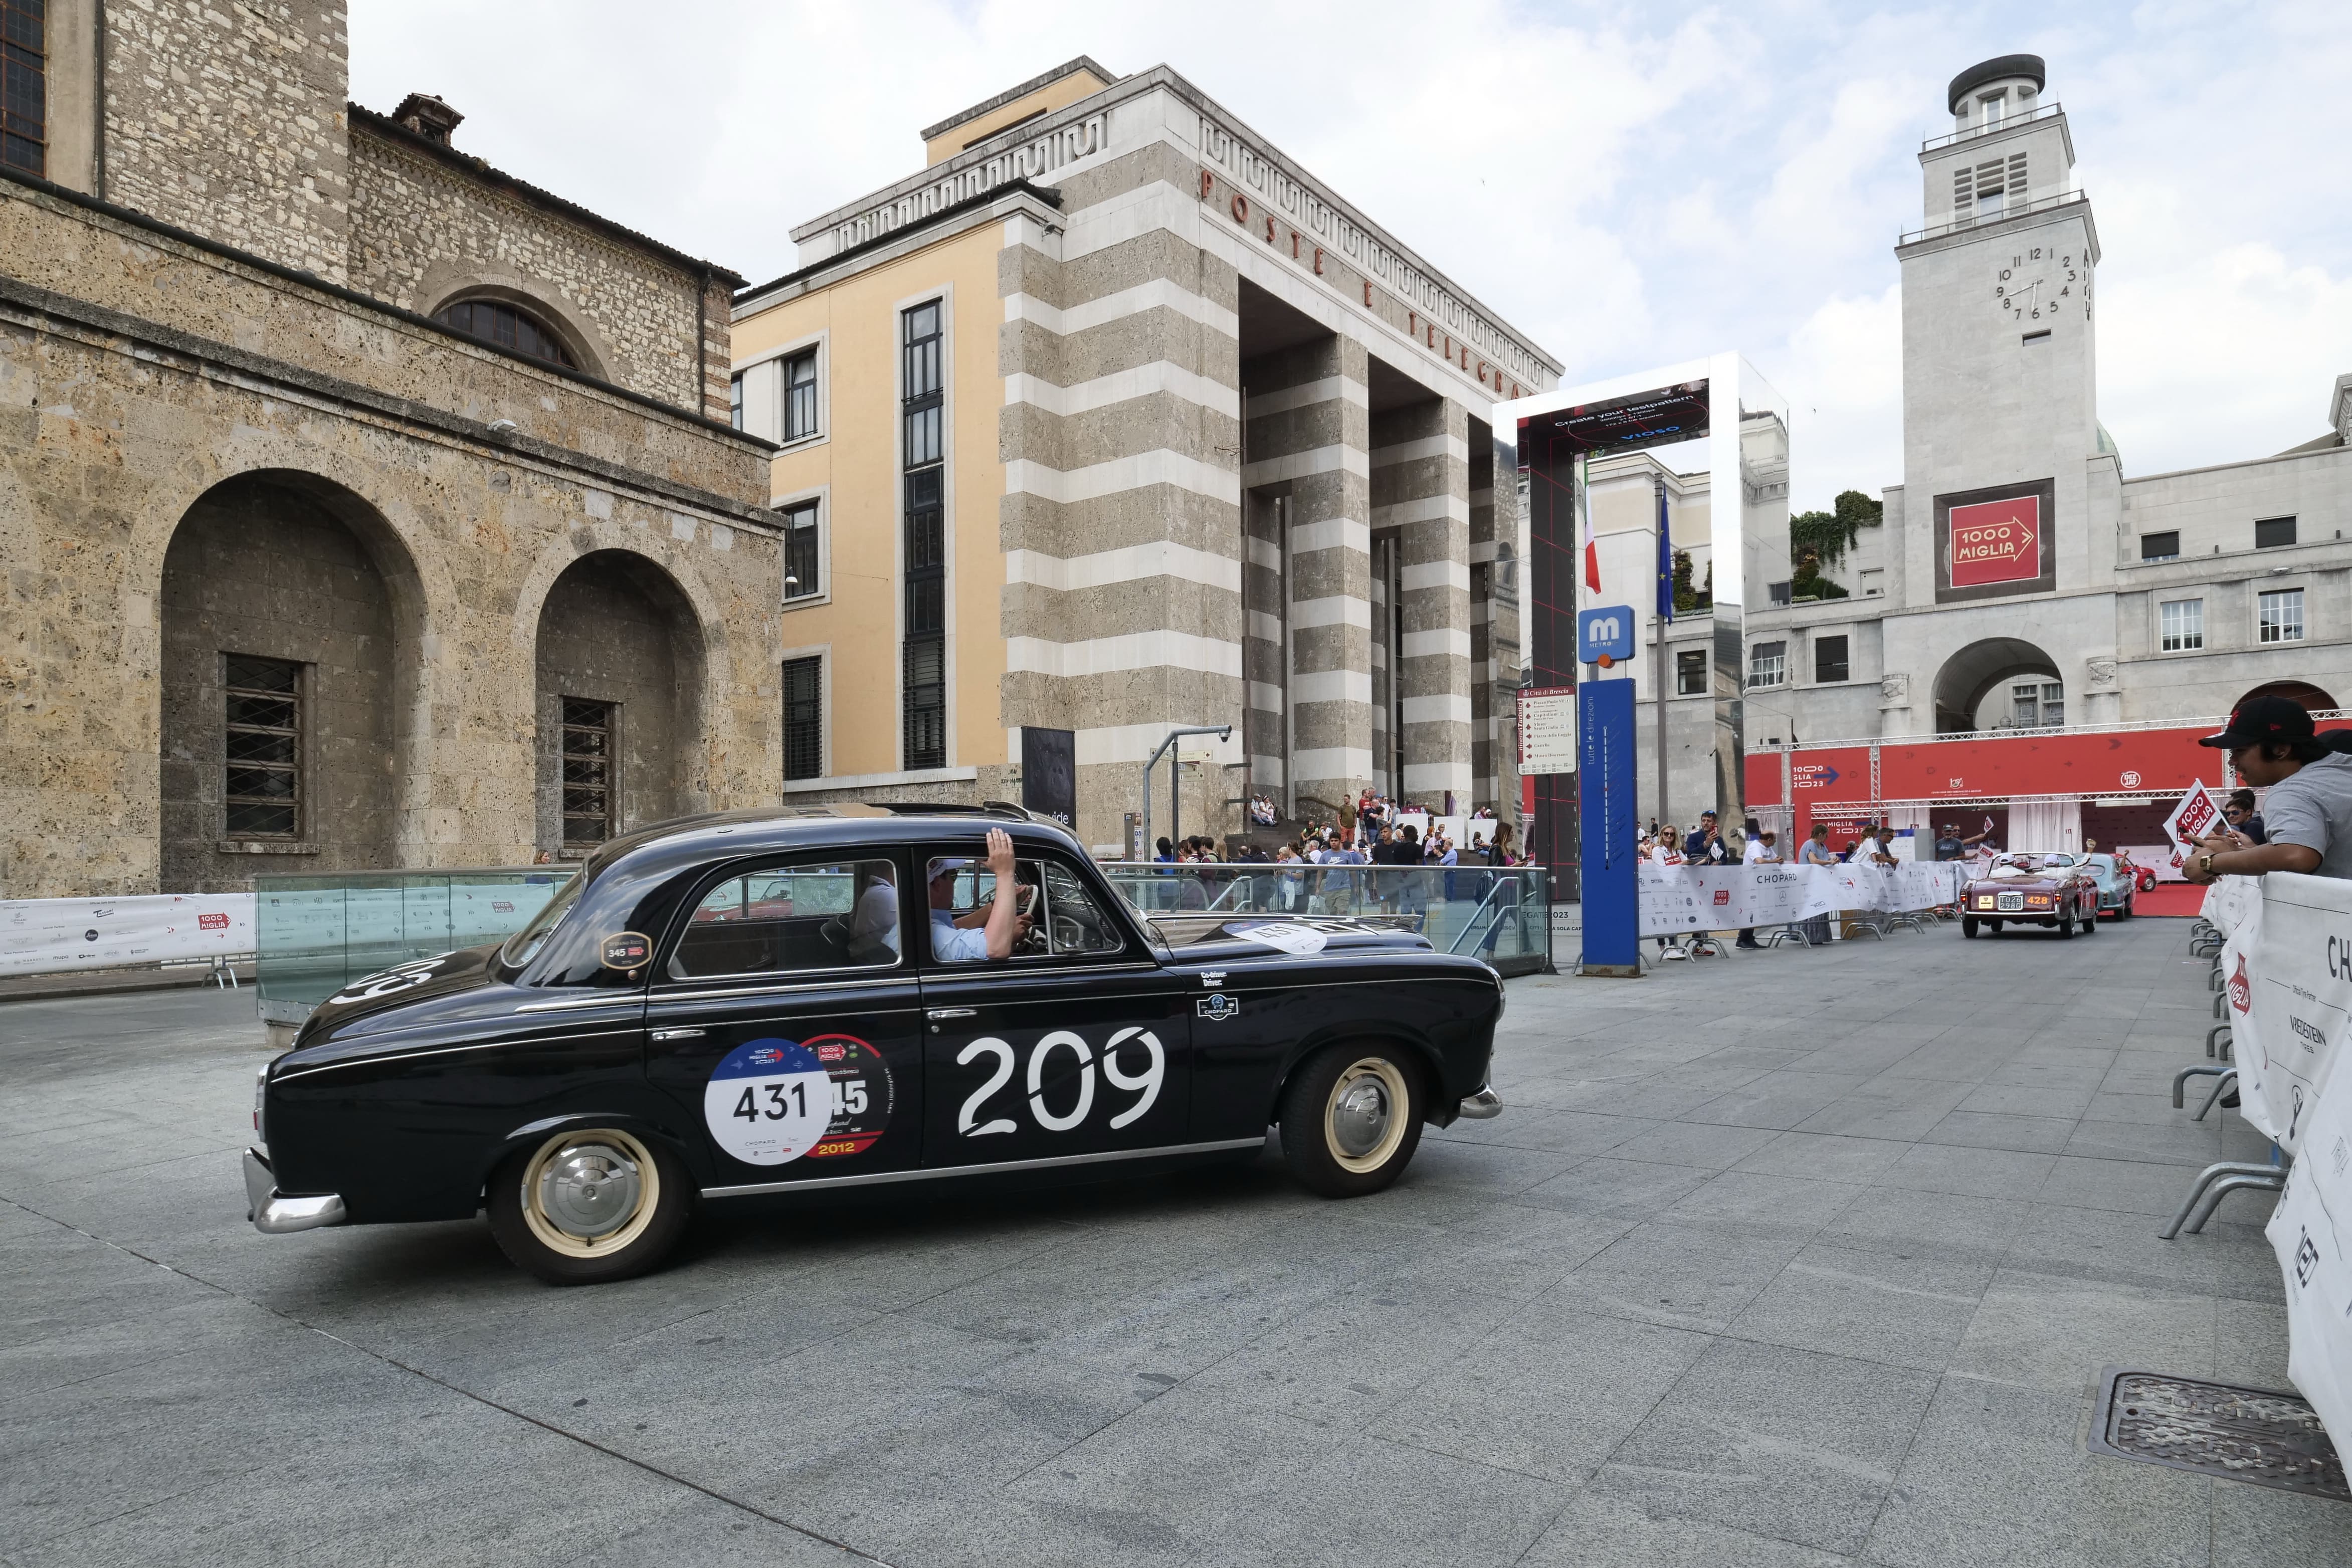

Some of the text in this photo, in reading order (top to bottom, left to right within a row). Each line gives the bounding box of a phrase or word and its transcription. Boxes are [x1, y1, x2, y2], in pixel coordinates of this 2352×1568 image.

[2031, 248, 2041, 260] 12
[2050, 248, 2053, 259] 1
[2014, 256, 2021, 267] 11
[2063, 256, 2070, 267] 2
[2000, 270, 2011, 282] 10
[2068, 270, 2076, 281] 3
[1201, 170, 1534, 400] POSTE E TELEGRA
[1997, 287, 2004, 297] 9
[2060, 286, 2069, 297] 4
[2004, 298, 2011, 309] 8
[2050, 301, 2058, 312] 5
[2015, 308, 2021, 320] 7
[2032, 308, 2040, 319] 6
[1555, 395, 1694, 427] Create your testpattern
[1621, 426, 1680, 440] VIOSO
[1962, 526, 2010, 543] 1000
[1959, 542, 2014, 559] MIGLIA
[1586, 696, 1594, 733] direzioni
[1587, 734, 1595, 743] le
[2182, 797, 2203, 826] 1000
[1756, 873, 1797, 884] CHOPARD
[2027, 896, 2048, 904] 428
[1253, 926, 1301, 939] 431
[608, 948, 626, 957] 345
[2290, 1014, 2326, 1046] VREDESTEIN
[956, 1026, 1165, 1136] 209
[733, 1081, 806, 1122] 431
[818, 1142, 855, 1155] 2012
